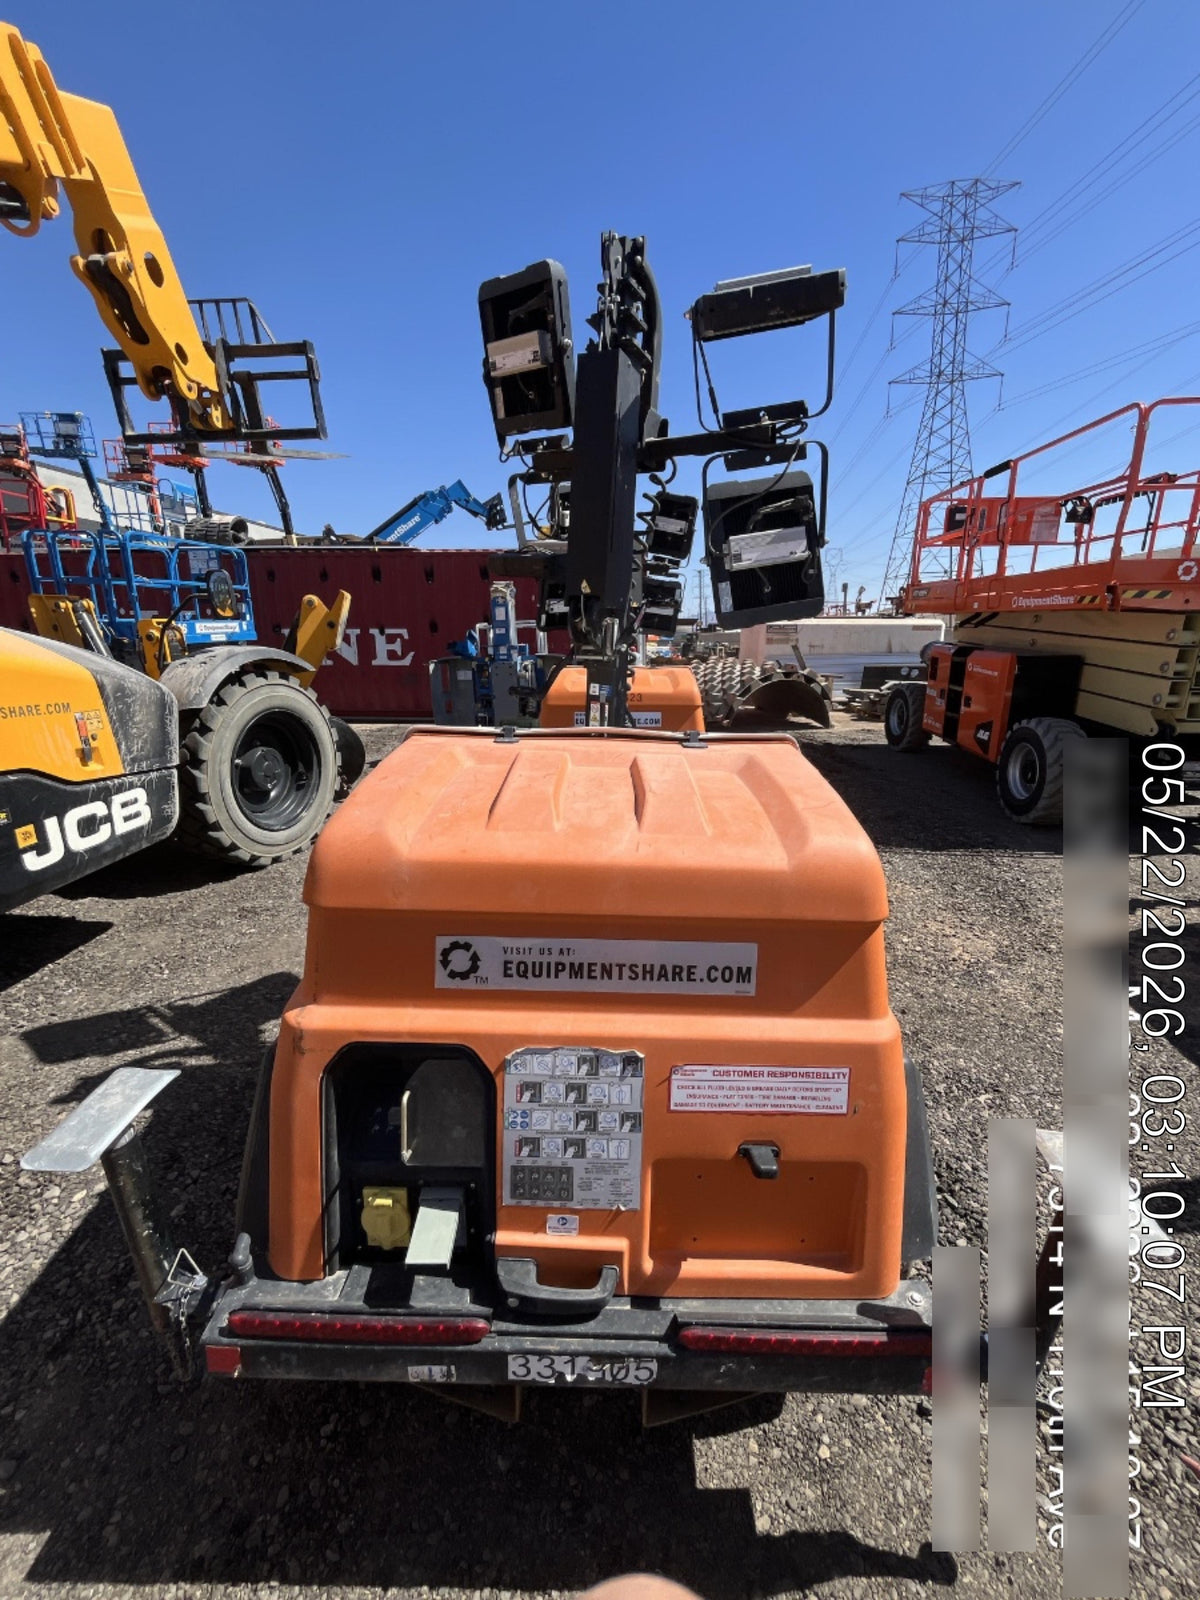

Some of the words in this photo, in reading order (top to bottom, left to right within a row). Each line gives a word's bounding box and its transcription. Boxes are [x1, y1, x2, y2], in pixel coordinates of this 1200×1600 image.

[0, 703, 72, 719] SHARE.COM
[22, 788, 152, 872] JCB
[502, 946, 533, 956] VISIT
[539, 947, 553, 956] US
[558, 947, 576, 957] AT:
[502, 960, 753, 984] EQUIPMENTSHARE.COM
[712, 1069, 765, 1078] CUSTOMER
[767, 1070, 848, 1080] RESPONSIBILITY
[511, 1355, 656, 1382] 33105
